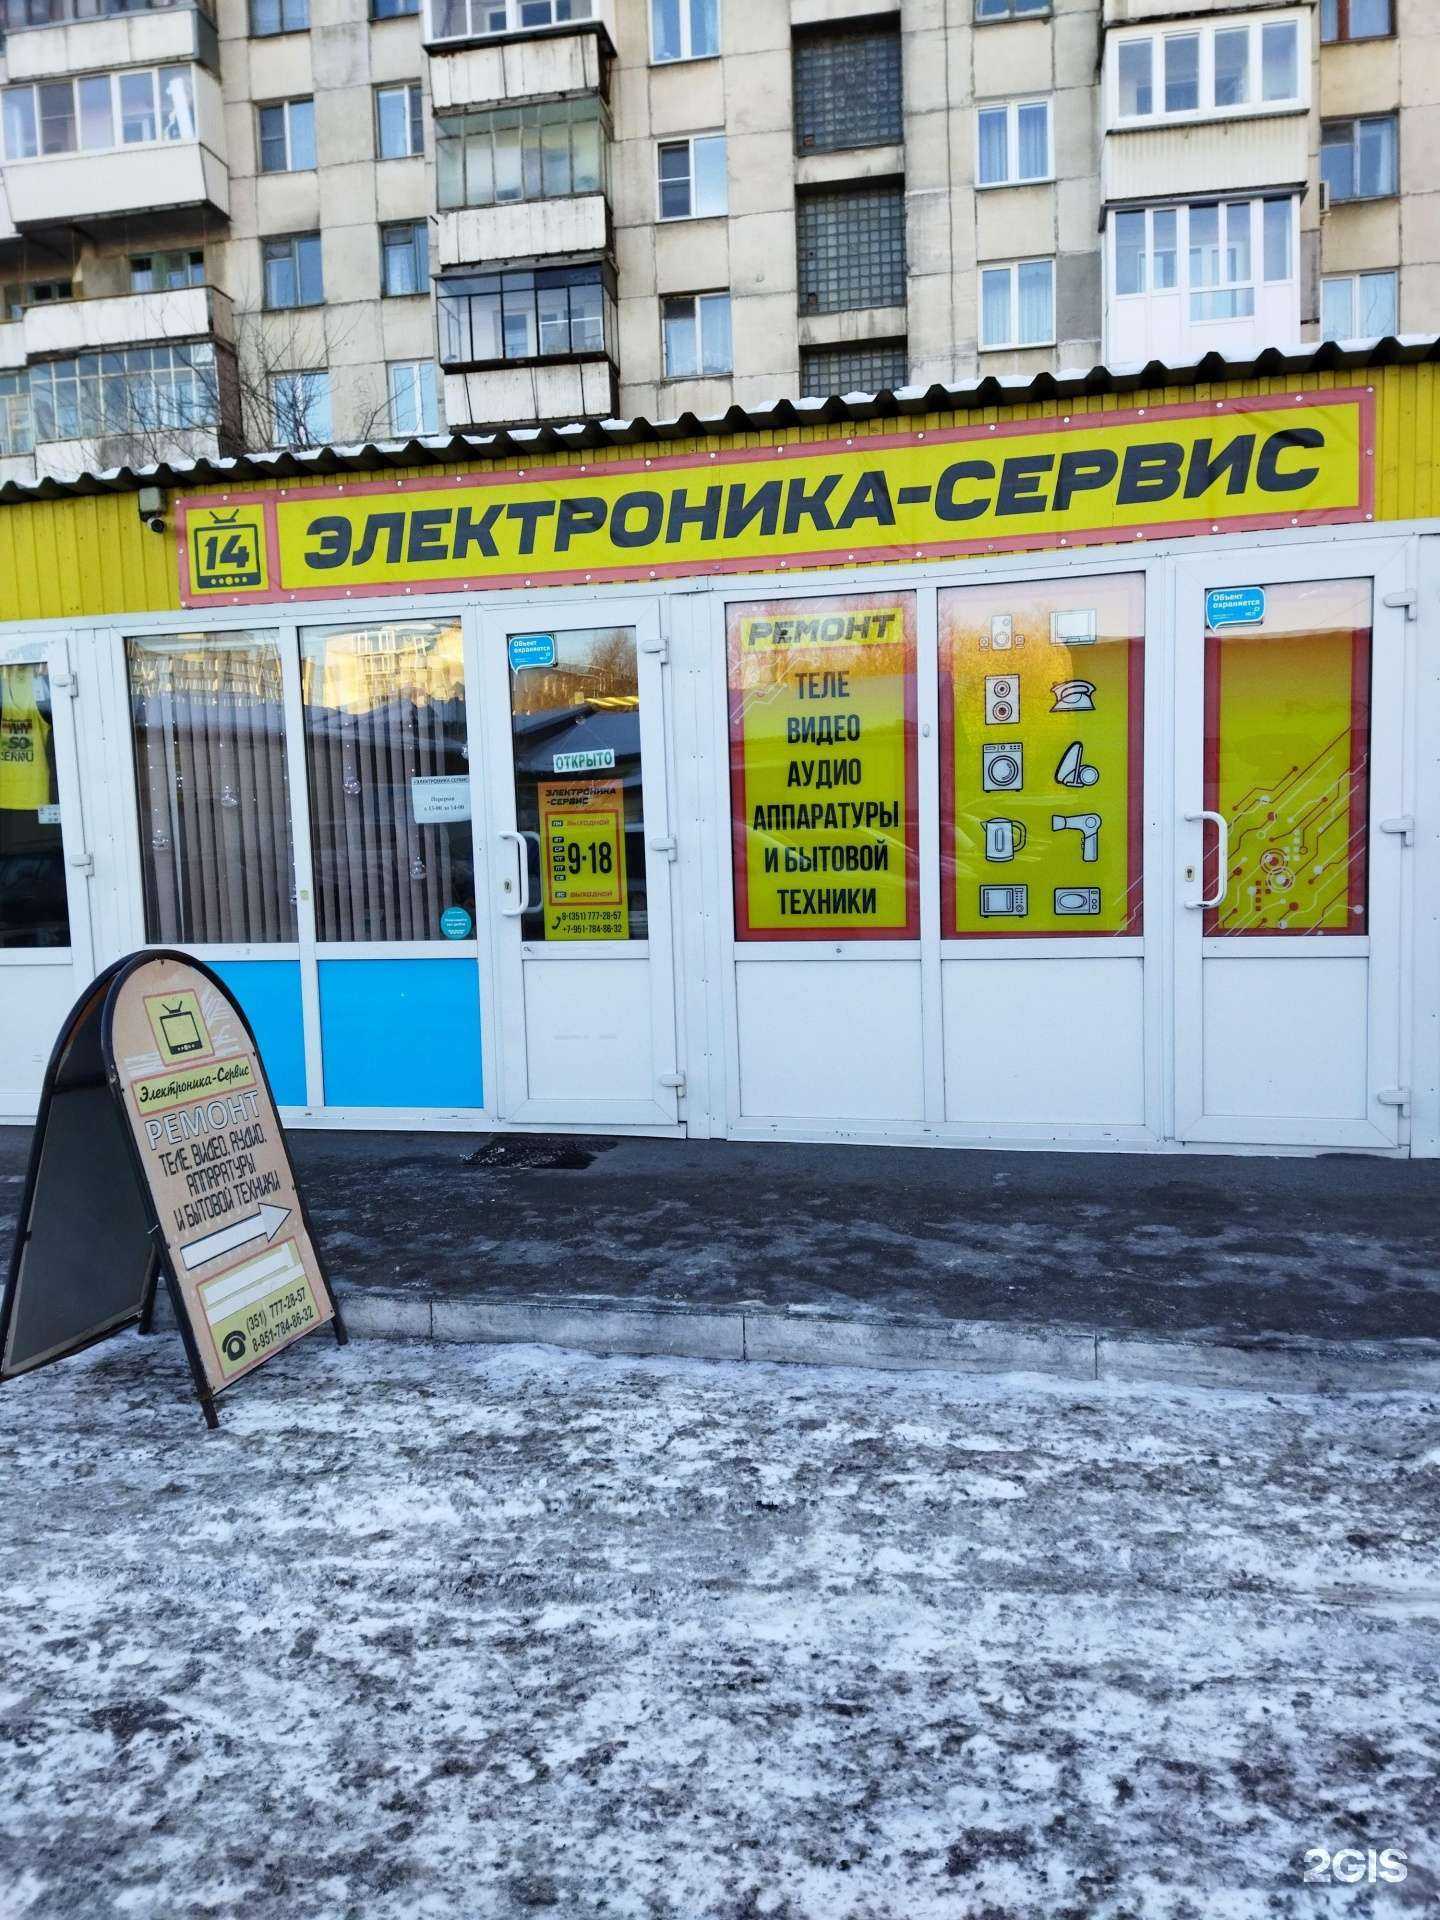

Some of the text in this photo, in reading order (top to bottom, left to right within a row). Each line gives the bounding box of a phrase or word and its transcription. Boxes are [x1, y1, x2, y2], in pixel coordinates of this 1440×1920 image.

[304, 427, 1325, 570] ЭЛЕКТРОНИКА-СЕРВИС
[204, 534, 250, 570] 14
[749, 614, 895, 645] РЕМОНТ
[795, 671, 850, 699] ТЕЛЕ
[787, 714, 860, 745] ВИДЕО
[556, 751, 612, 770] ОТКРЫТО
[787, 758, 862, 789] АУДИО
[545, 787, 616, 796] ЭЛЕКТРОНИКА
[753, 801, 899, 831] АППАРАТУРЫ
[765, 840, 888, 873] И БЫТОВОЙ
[777, 888, 877, 915] ТЕХНИКИ
[139, 1064, 249, 1102] Электроника-Сервис
[144, 1090, 260, 1150] РЕМОНТ
[186, 1153, 257, 1197] АППАРАТУРЫ
[173, 1170, 281, 1232] И БЫТОВОЙ ТЕХНИКИ
[246, 1287, 306, 1335] (351) 777-28-57
[252, 1305, 314, 1353] 8-951-784-86-32
